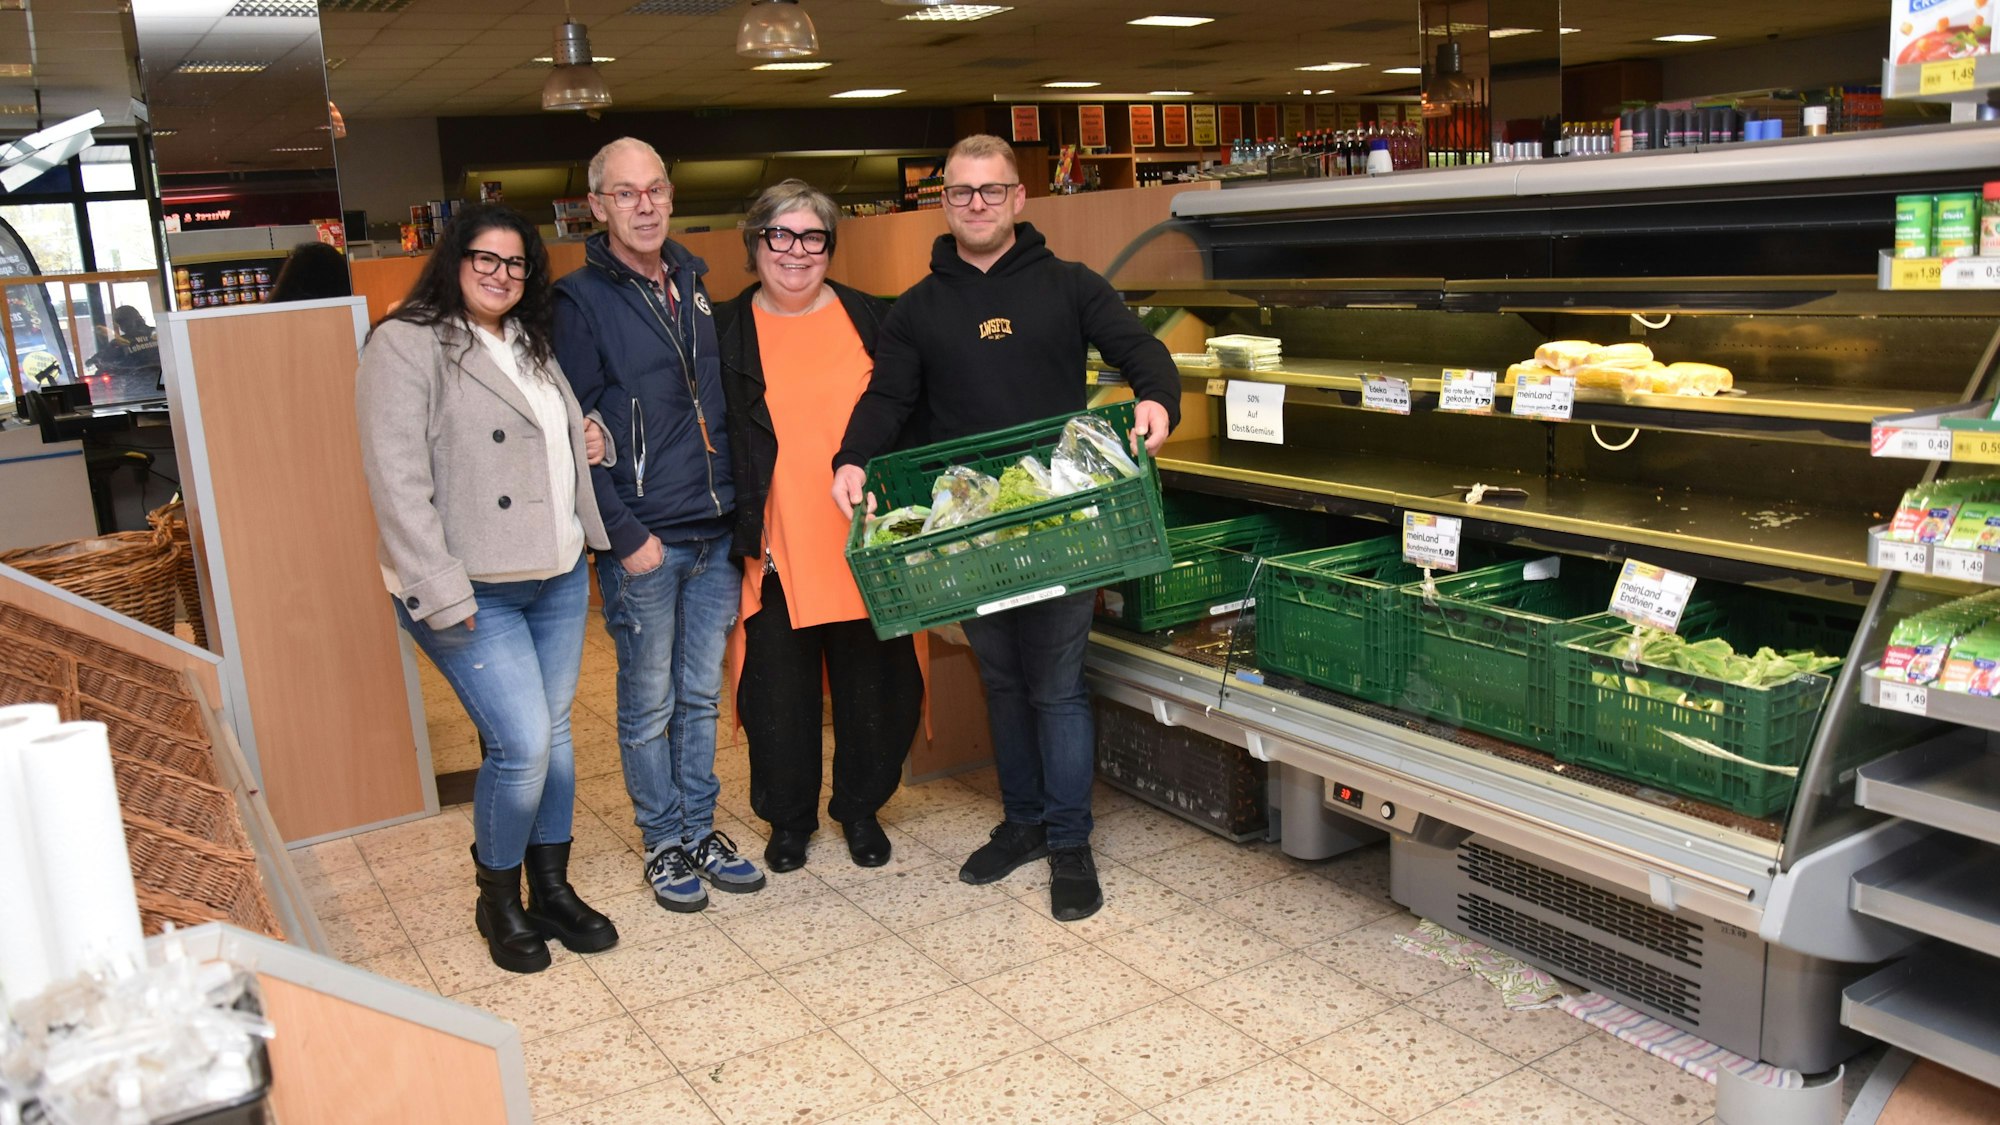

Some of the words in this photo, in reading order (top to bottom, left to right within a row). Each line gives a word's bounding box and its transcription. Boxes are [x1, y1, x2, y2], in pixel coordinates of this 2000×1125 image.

[1952, 67, 1974, 81] 1,49
[1921, 267, 1941, 278] 1,99
[1369, 386, 1387, 394] Edeka
[1517, 391, 1553, 400] meinLand
[1247, 395, 1260, 403] 50%
[1445, 395, 1472, 404] gekocht
[1232, 424, 1275, 436] Obst&Gemüse
[1928, 439, 1949, 450] 0,49
[1406, 532, 1439, 544] meinLand
[1406, 542, 1438, 554] Bundmöhren
[1438, 548, 1455, 557] 1,99
[1905, 551, 1925, 564] 1,49
[1961, 560, 1983, 571] 1,49
[1620, 582, 1663, 600] meinLand
[1620, 591, 1654, 610] Endivien
[1655, 606, 1677, 618] 2,49
[1906, 692, 1926, 705] 1,49
